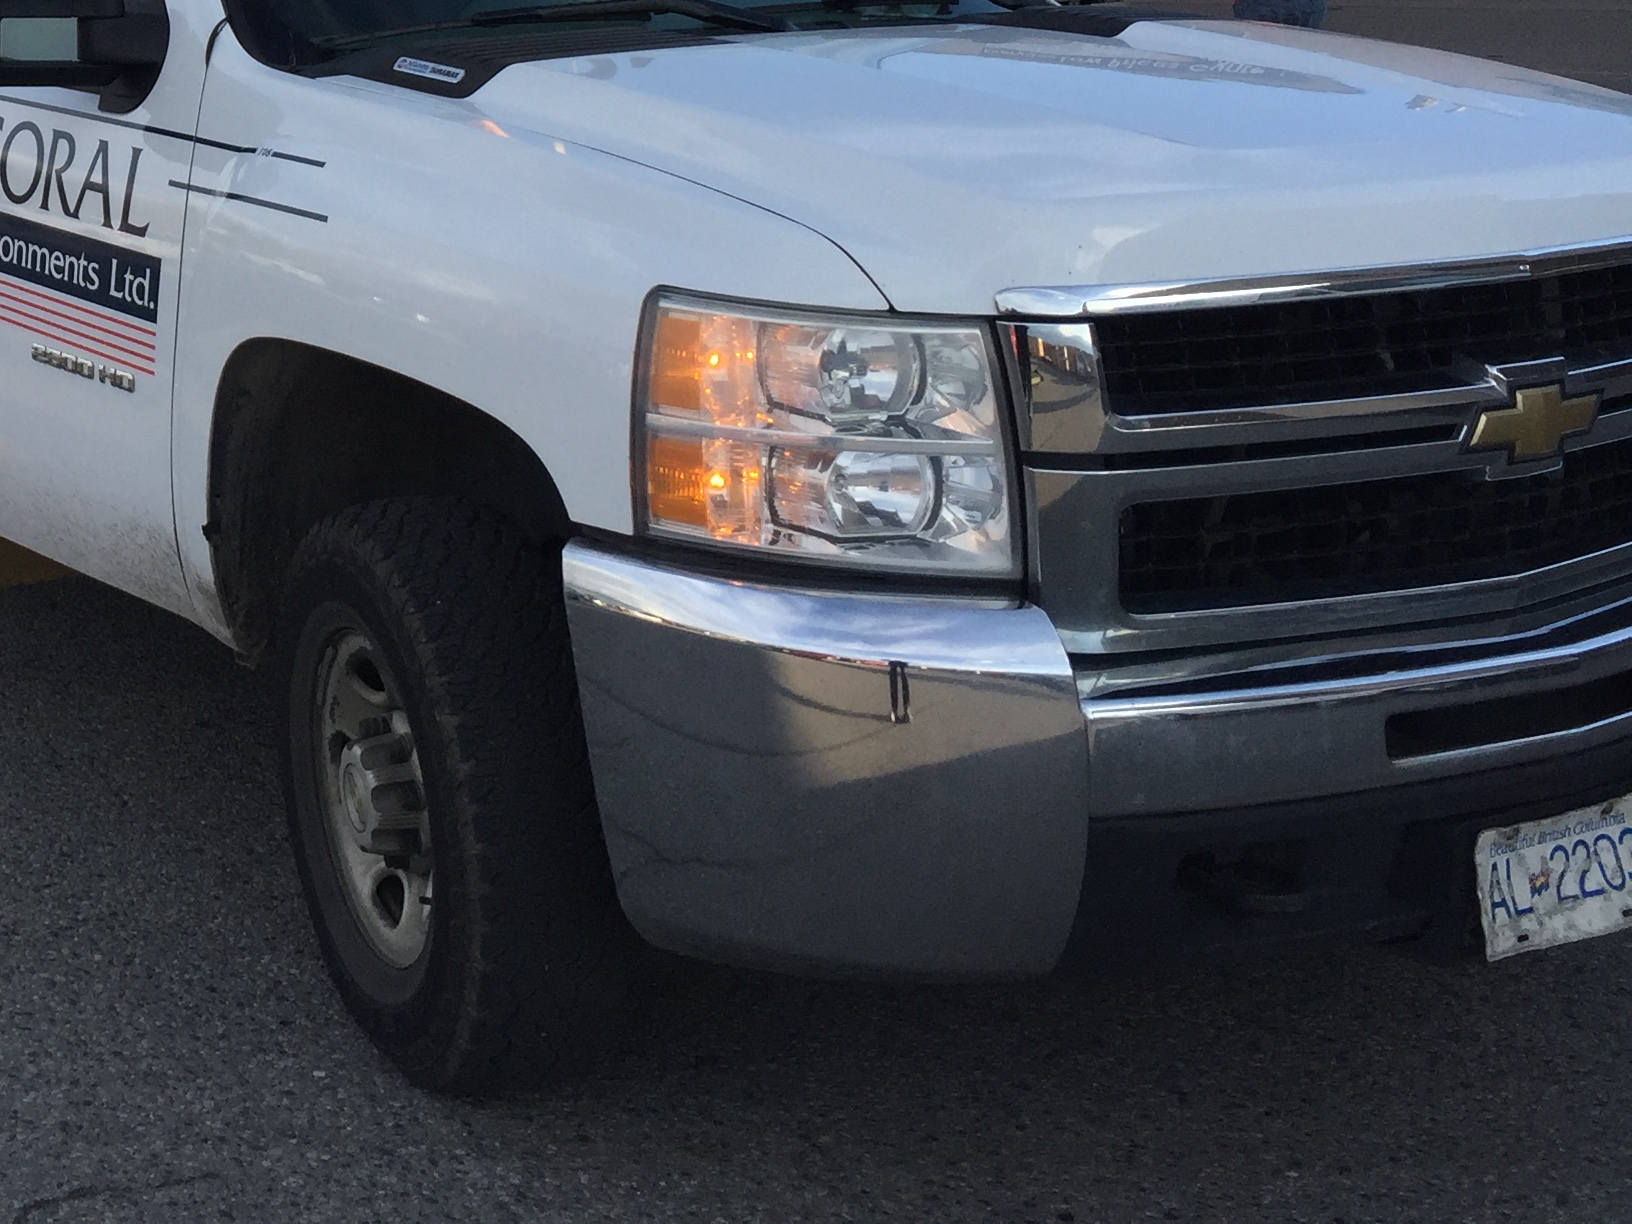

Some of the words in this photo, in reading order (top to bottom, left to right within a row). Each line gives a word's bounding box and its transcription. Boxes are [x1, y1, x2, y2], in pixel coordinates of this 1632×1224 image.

[109, 257, 155, 310] Ltd.
[31, 342, 95, 380] 2500
[99, 364, 136, 394] HD
[1538, 825, 1572, 846] British
[1573, 812, 1626, 836] Columbia
[1489, 857, 1534, 924] AL
